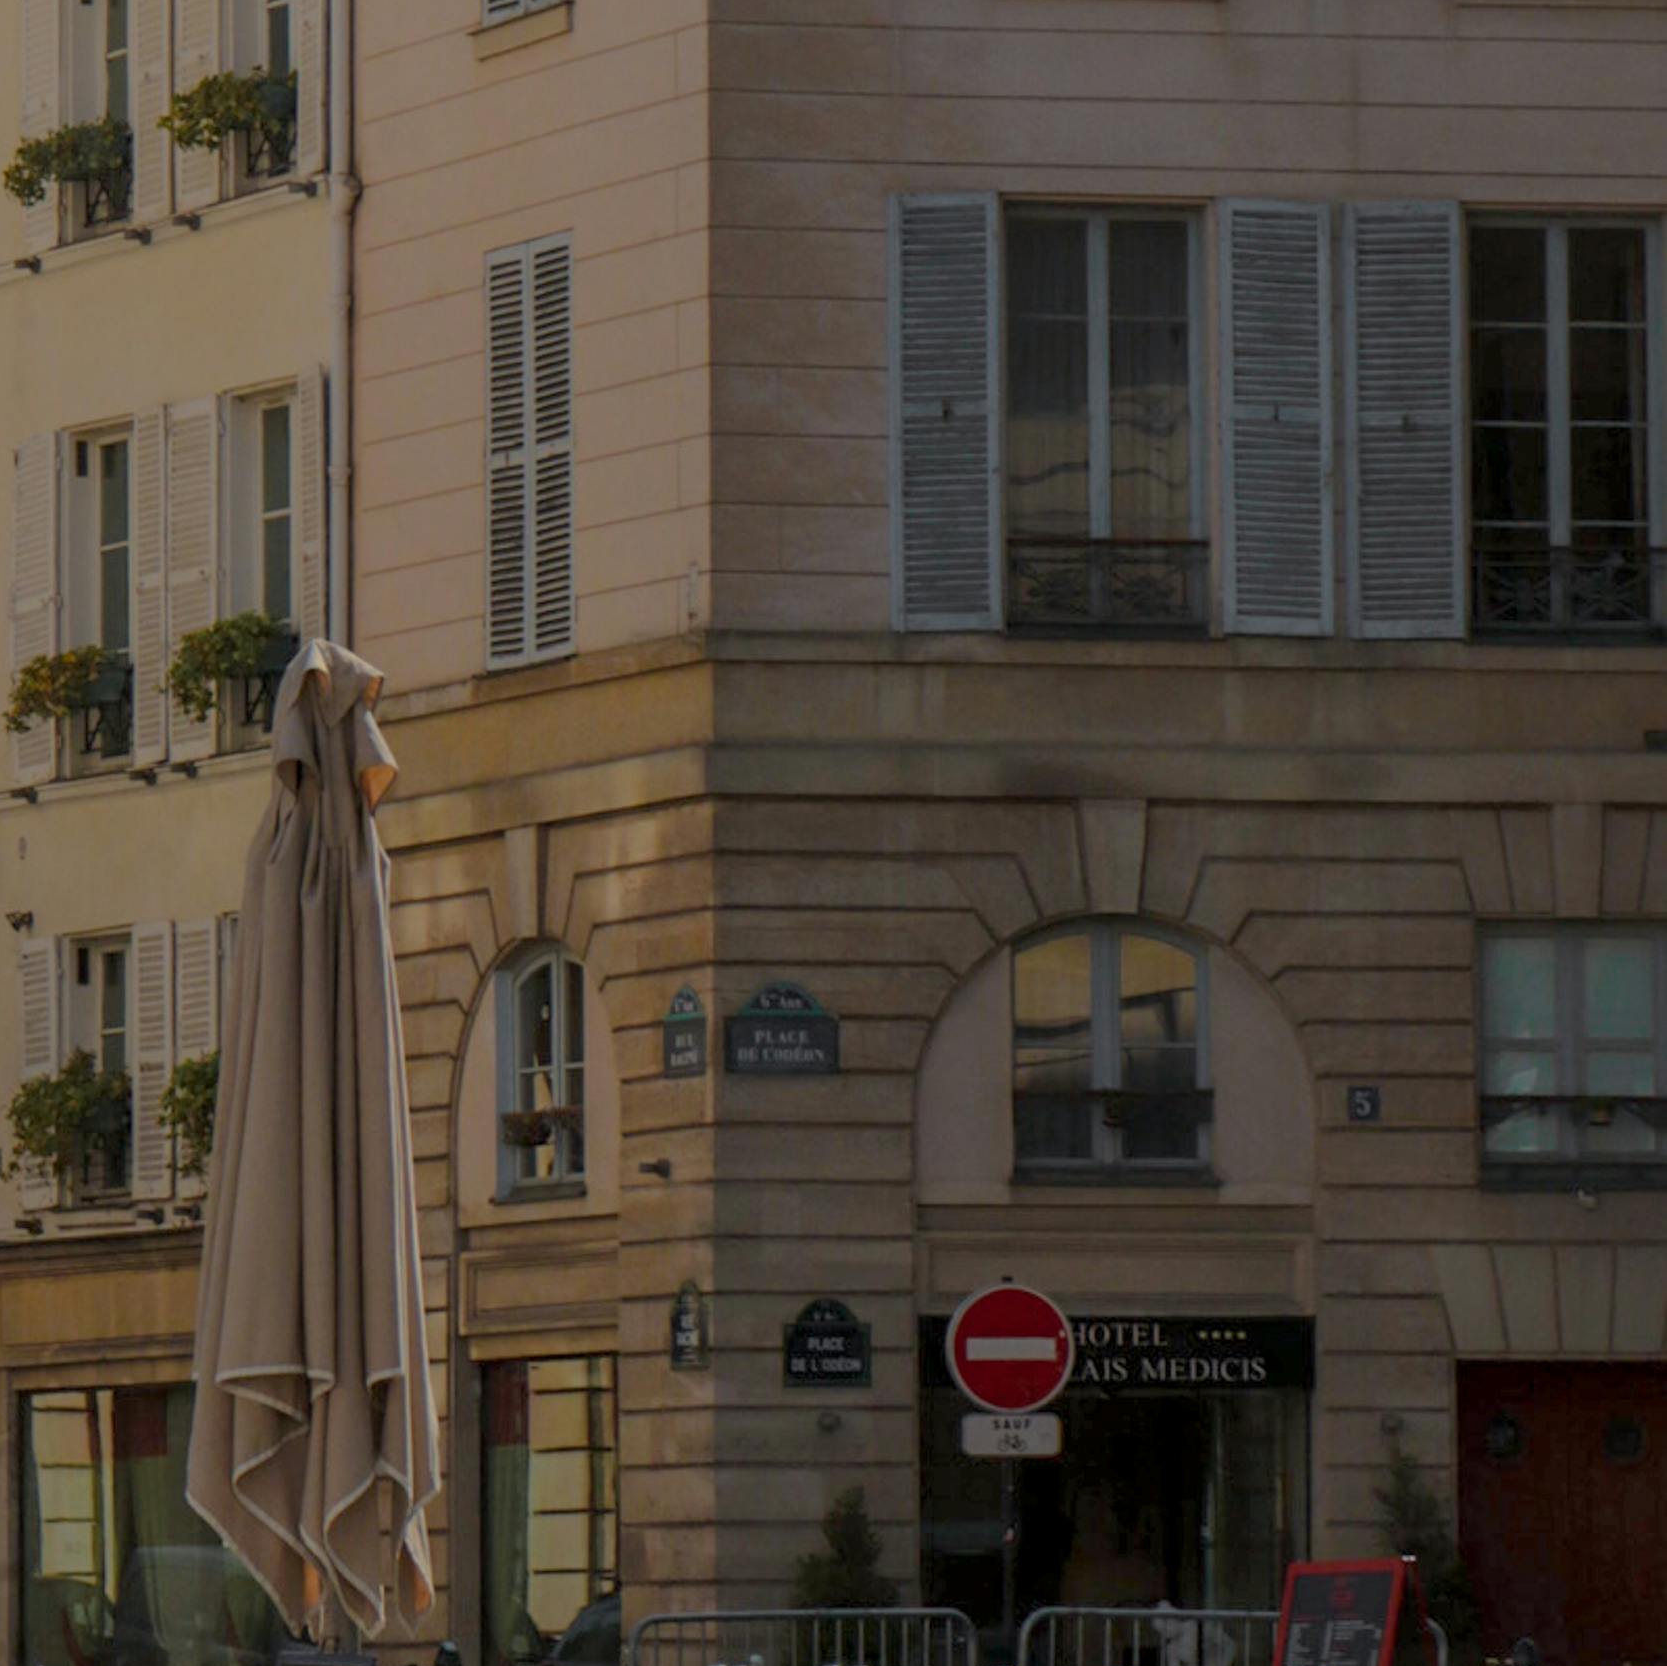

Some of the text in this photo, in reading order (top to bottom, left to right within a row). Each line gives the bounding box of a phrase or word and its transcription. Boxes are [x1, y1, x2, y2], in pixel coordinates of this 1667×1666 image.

[754, 1029, 810, 1045] PLACE
[737, 1048, 759, 1063] DE
[1355, 1090, 1372, 1117] 5
[807, 1336, 845, 1352] PLACE
[790, 1357, 806, 1373] DE
[1140, 1356, 1267, 1382] MEDICIS
[993, 1418, 1031, 1430] SAUF
